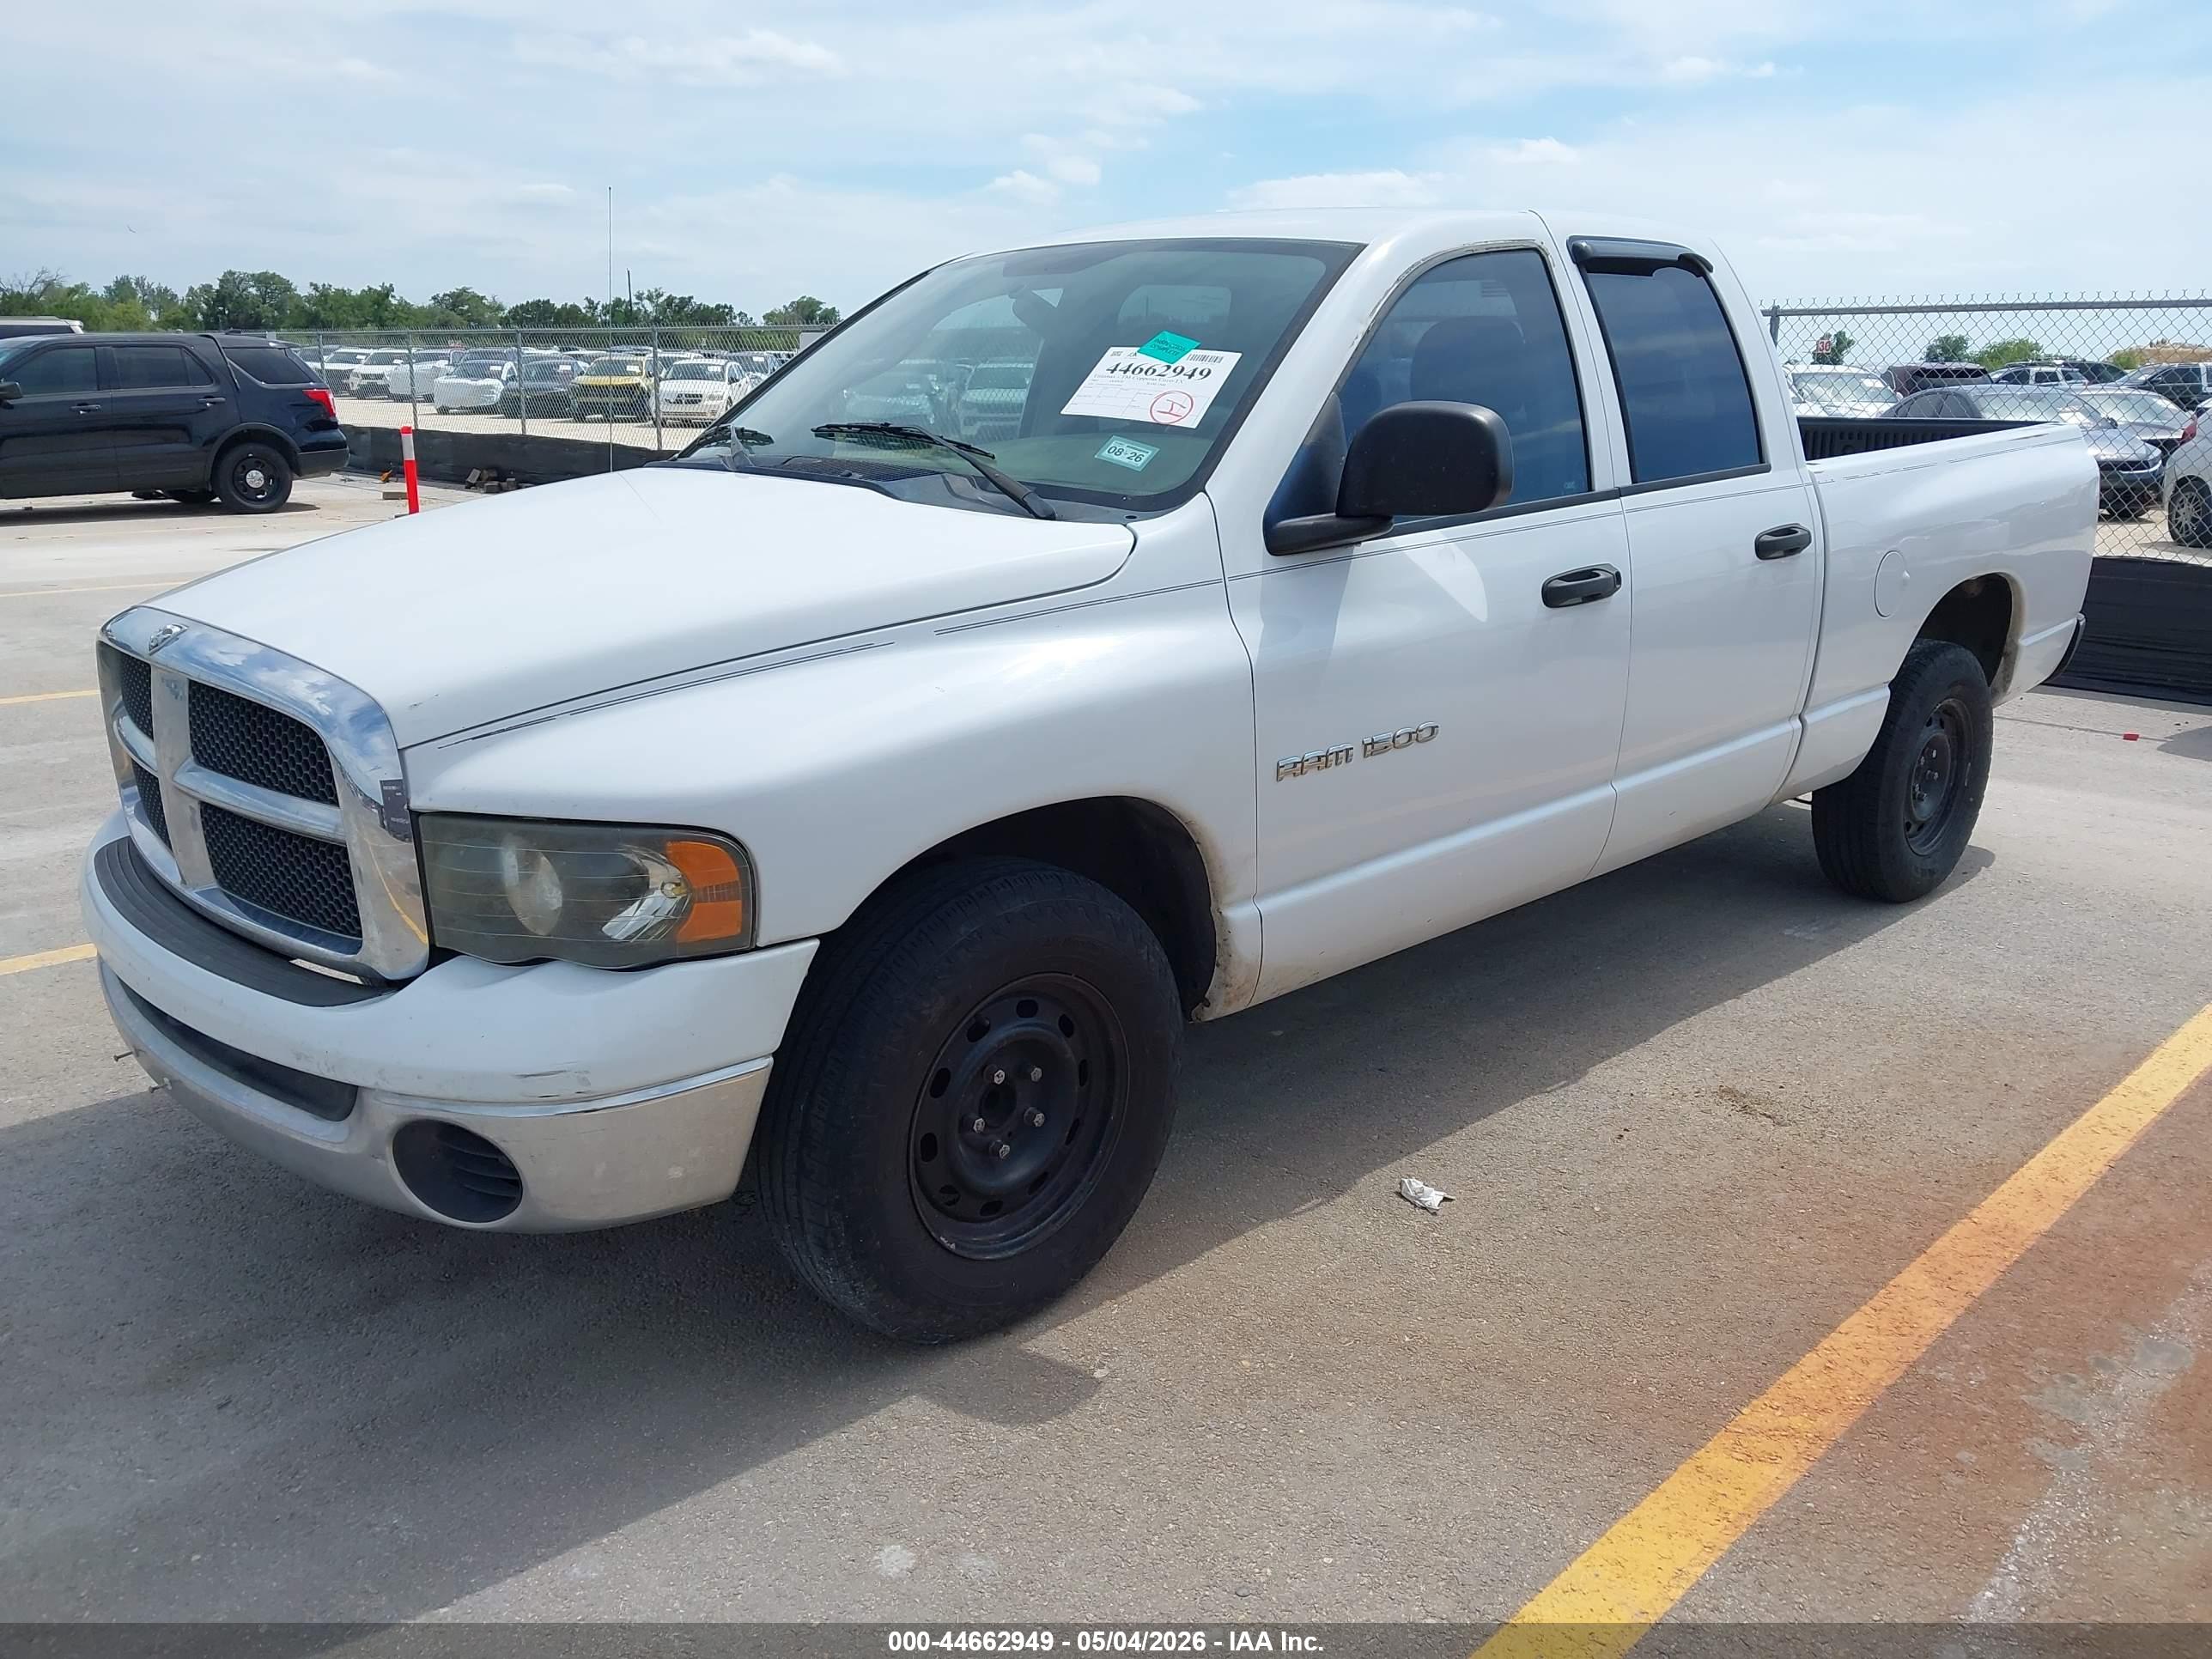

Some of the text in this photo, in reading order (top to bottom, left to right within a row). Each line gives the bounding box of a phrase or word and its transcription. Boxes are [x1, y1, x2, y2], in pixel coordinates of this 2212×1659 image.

[1819, 340, 1832, 352] 30
[1105, 362, 1212, 381] 44662949
[1276, 720, 1440, 782] RAM 1500
